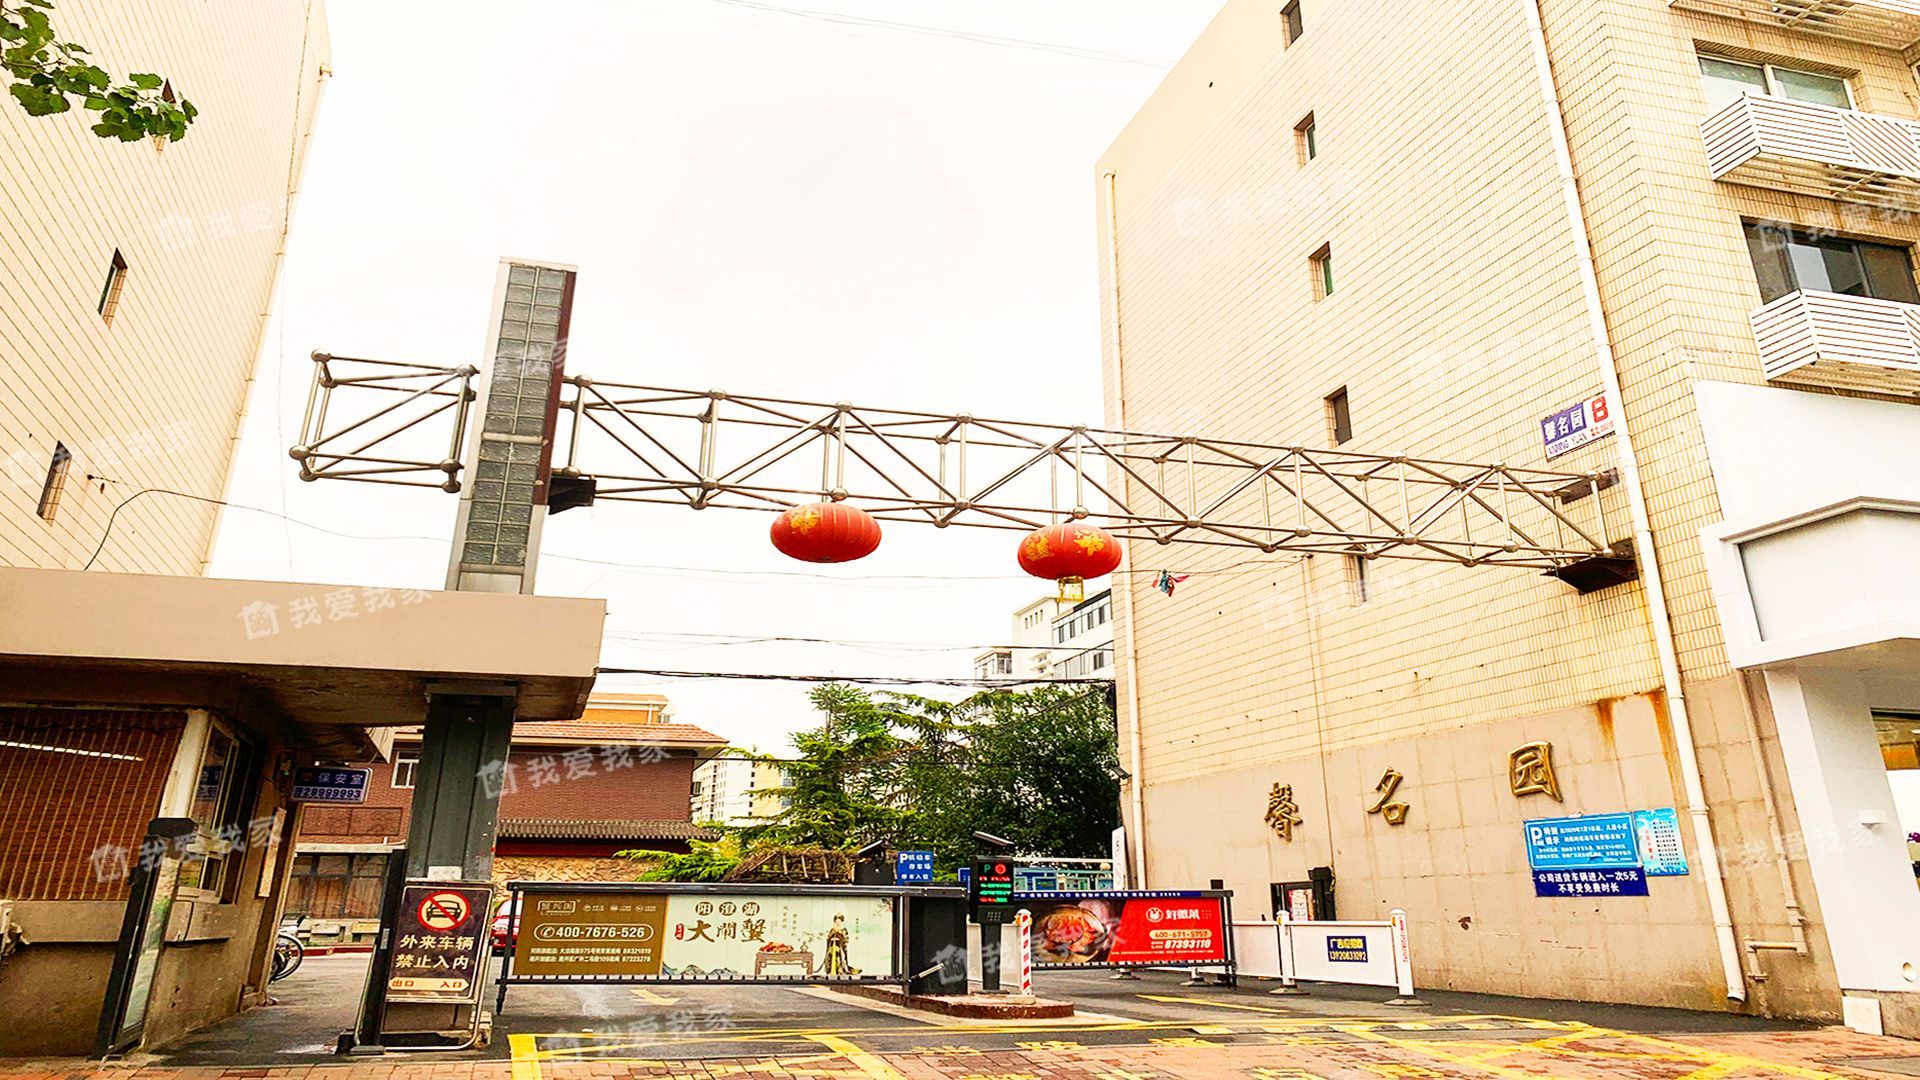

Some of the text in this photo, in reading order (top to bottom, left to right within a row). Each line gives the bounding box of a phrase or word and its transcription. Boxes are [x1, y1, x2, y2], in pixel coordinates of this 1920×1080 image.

[319, 772, 363, 785] 保安室
[556, 927, 645, 938] 400-7676-526
[400, 934, 475, 950] 外来车辆
[395, 954, 470, 970] 禁止入内
